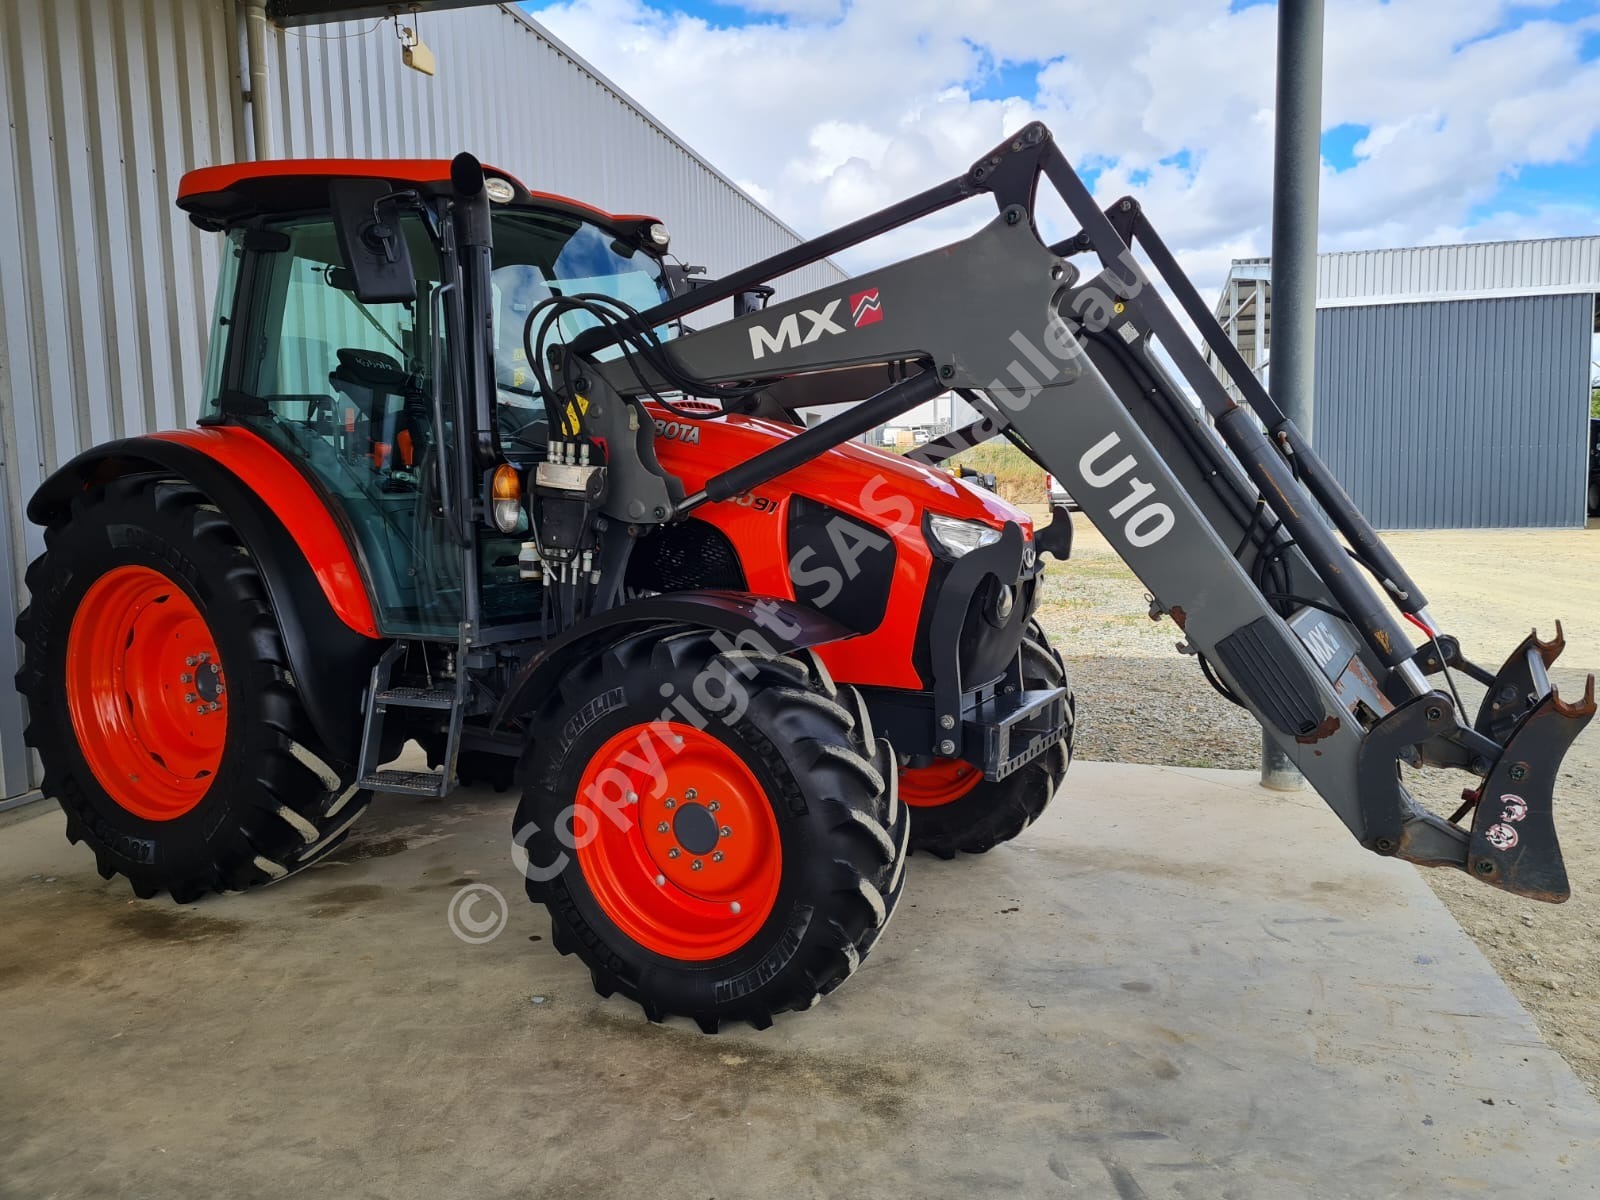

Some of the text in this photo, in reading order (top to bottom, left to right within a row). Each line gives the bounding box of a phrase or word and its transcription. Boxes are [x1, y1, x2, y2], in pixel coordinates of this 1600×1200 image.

[748, 298, 847, 360] MX
[654, 419, 700, 445] BOTA
[1079, 431, 1175, 547] U10
